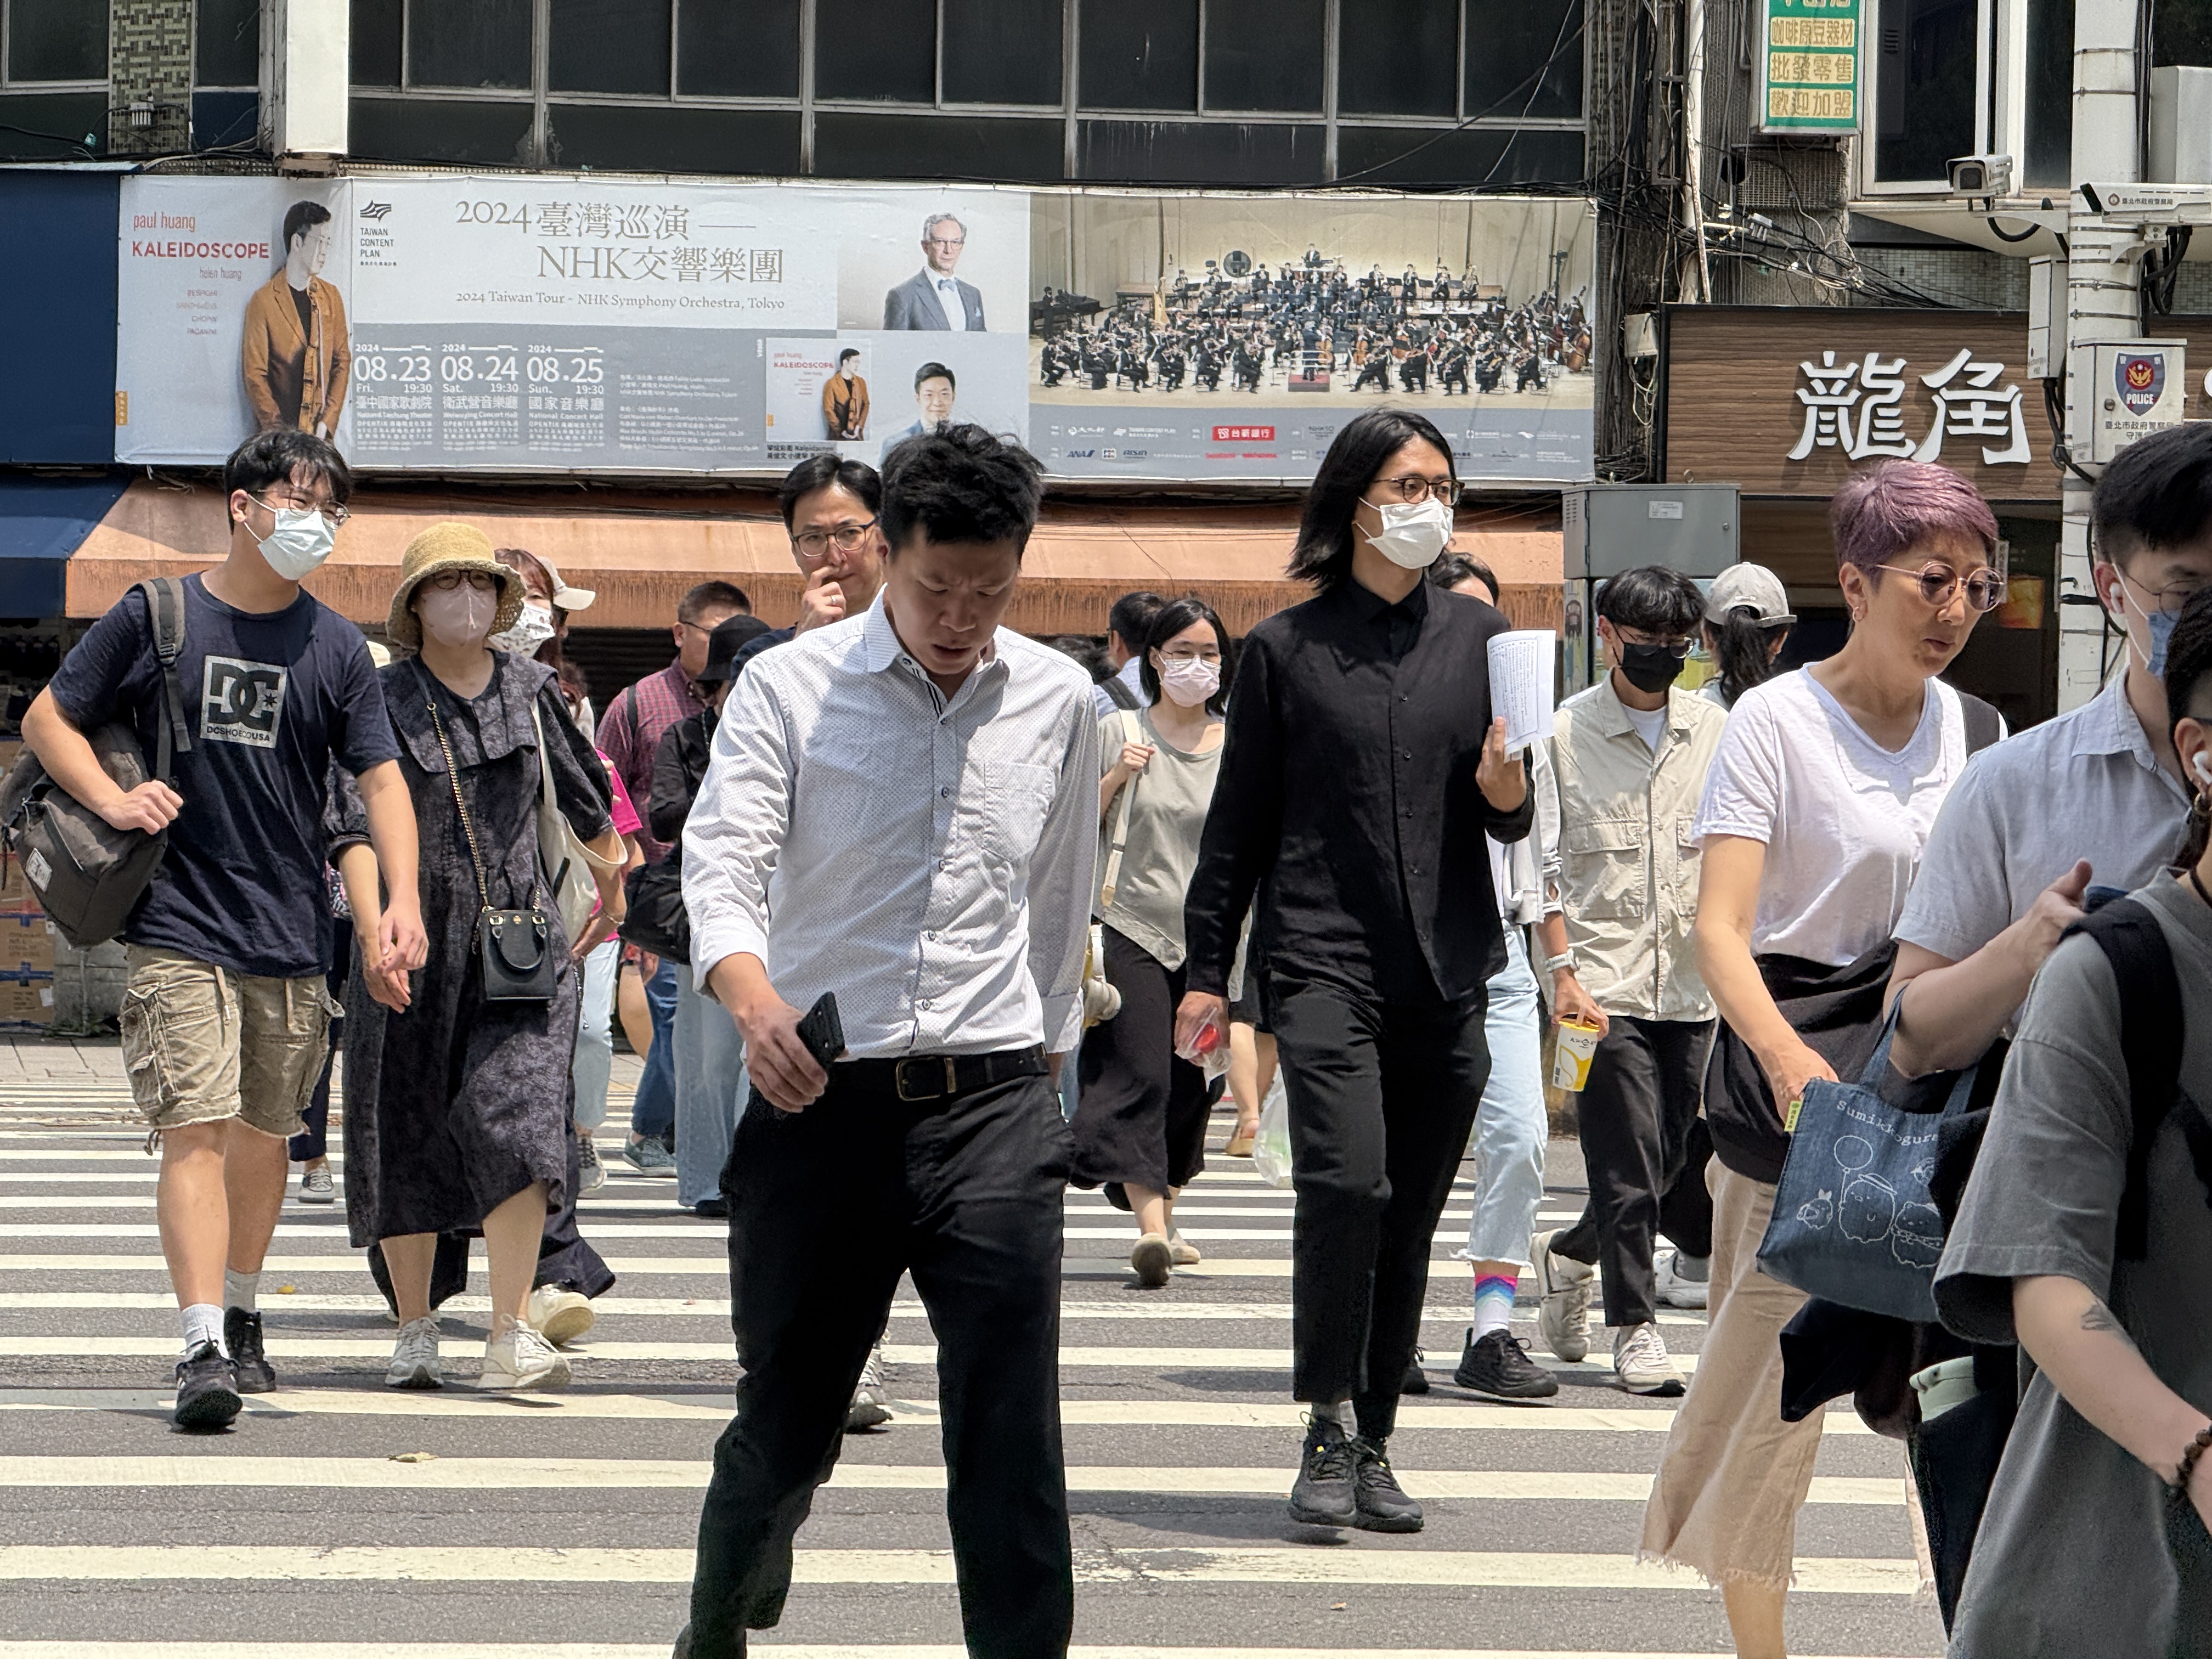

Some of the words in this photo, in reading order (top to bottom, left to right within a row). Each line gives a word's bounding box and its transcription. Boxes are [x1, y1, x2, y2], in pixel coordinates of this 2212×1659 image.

[1771, 19, 1854, 46] 咖啡原豆器材
[1771, 54, 1852, 81] 批發零售
[1770, 90, 1852, 117] 歡迎加盟
[134, 211, 156, 231] paul
[161, 211, 196, 233] huang
[360, 228, 388, 236] TAIWAN
[132, 241, 270, 258] KALEIDOSCOPE
[360, 238, 394, 247] CONTENT
[360, 249, 380, 257] PLAN
[537, 245, 783, 284] NHK交響樂團
[199, 267, 218, 278] helen
[221, 267, 242, 281] huang
[456, 293, 485, 303] 2024
[488, 291, 532, 302] Taiwan
[536, 292, 565, 303] Tour
[578, 294, 608, 305] NHK
[611, 295, 676, 308] Symphony
[680, 296, 744, 309] Orchestra,
[748, 297, 785, 309] Tokyo
[356, 344, 379, 352] 2024
[528, 345, 552, 353] 2024
[354, 356, 431, 381] 08.23
[441, 356, 519, 381] 08.24
[527, 357, 603, 383] 08.25
[357, 383, 374, 393] Fri.
[404, 384, 432, 393] 19:30
[443, 383, 464, 393] Sat.
[490, 383, 519, 393] 19:30
[528, 384, 553, 393] Sun.
[576, 385, 603, 394] 19:30
[528, 396, 604, 410] 國家音樂廳
[2126, 393, 2154, 404] POLICE
[1787, 348, 2031, 465] 龍角
